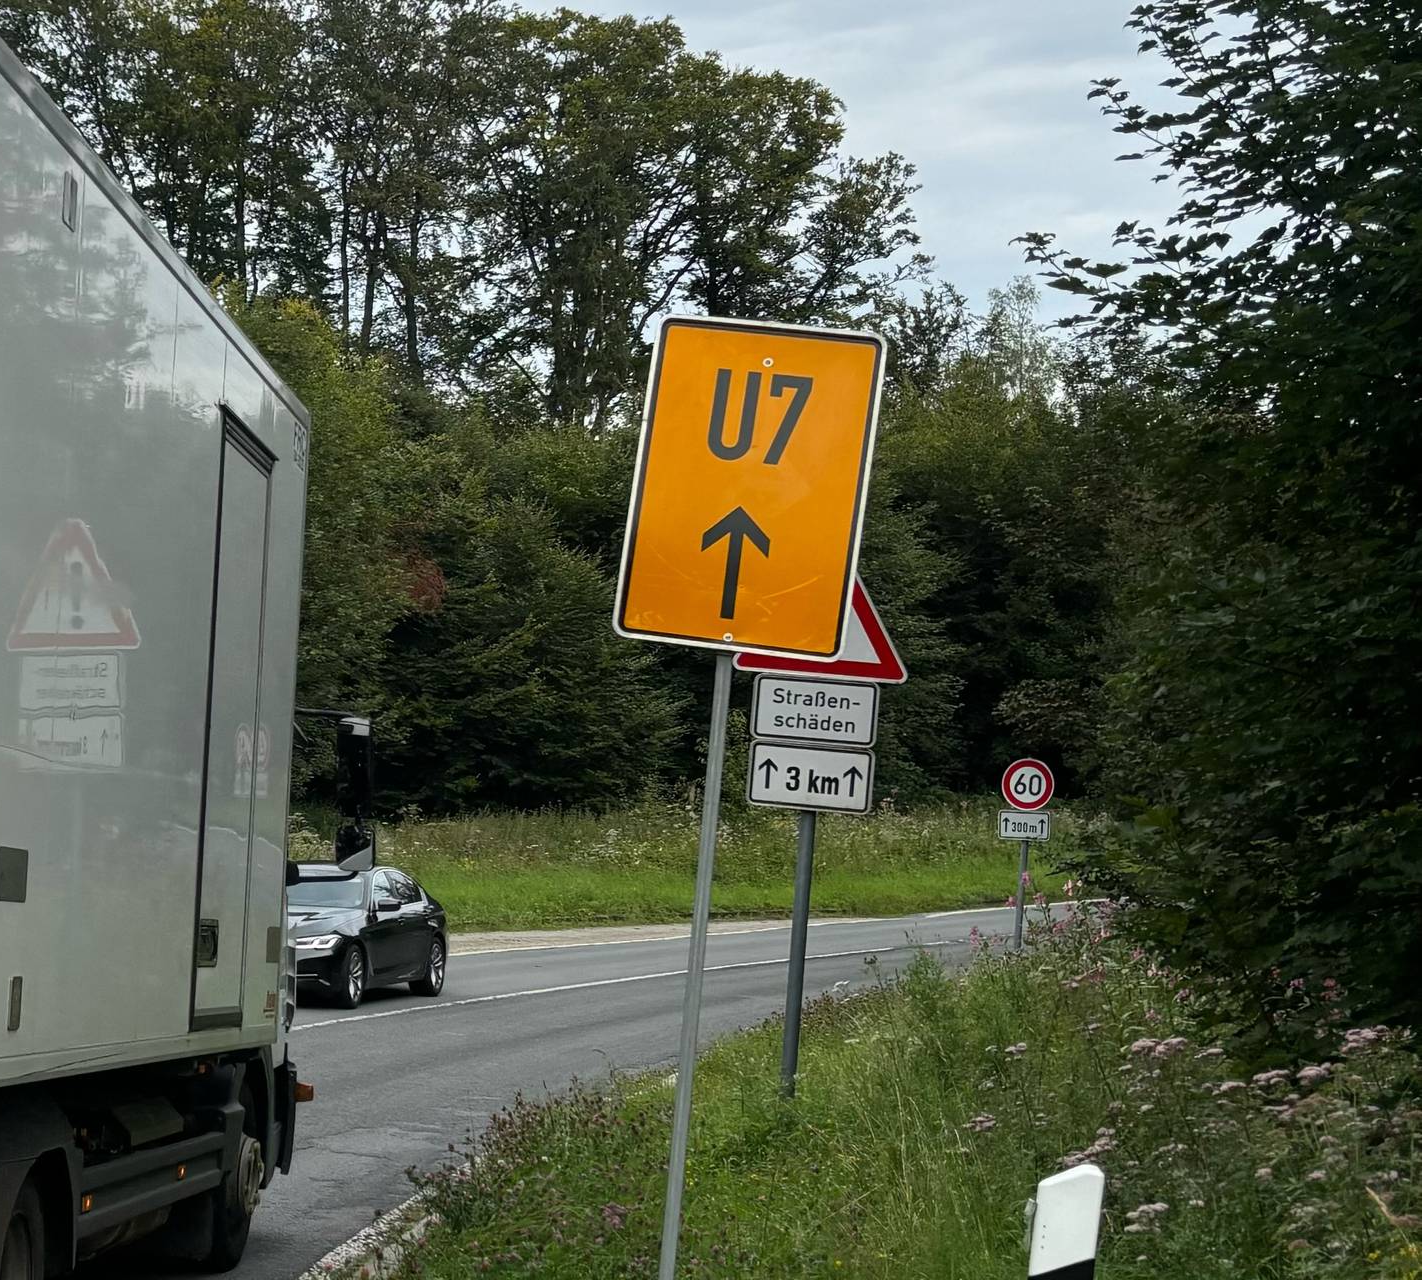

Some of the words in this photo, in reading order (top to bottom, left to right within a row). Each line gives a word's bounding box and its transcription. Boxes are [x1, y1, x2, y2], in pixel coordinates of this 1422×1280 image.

[708, 368, 814, 465] U7
[772, 688, 861, 710] Straßen-
[773, 713, 856, 733] schäden
[785, 766, 800, 791] 3
[807, 769, 839, 795] km
[1014, 773, 1042, 796] 60
